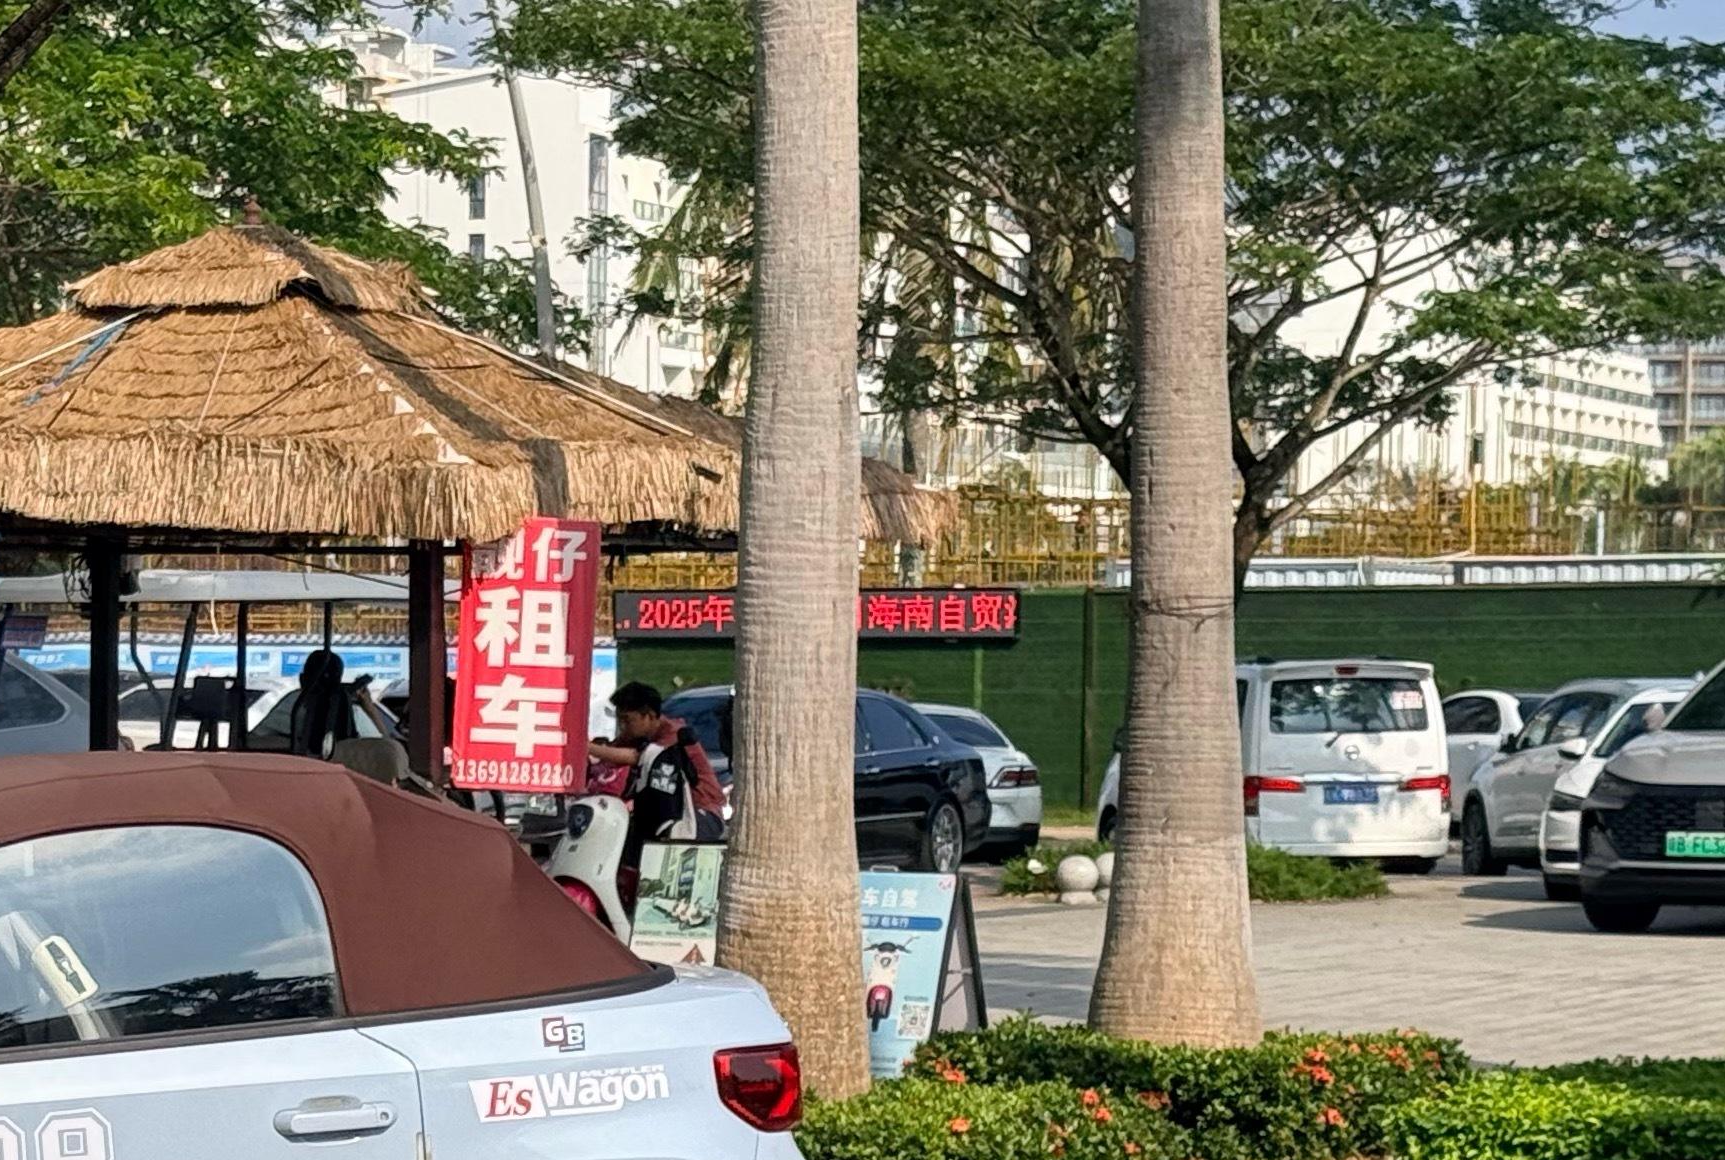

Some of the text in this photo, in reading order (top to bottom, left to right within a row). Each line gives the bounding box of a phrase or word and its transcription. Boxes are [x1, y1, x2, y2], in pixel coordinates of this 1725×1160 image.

[856, 594, 1017, 632] 海南自贸
[470, 586, 574, 758] 租车
[544, 1019, 585, 1047] GB
[485, 1070, 670, 1118] Es Wagon
